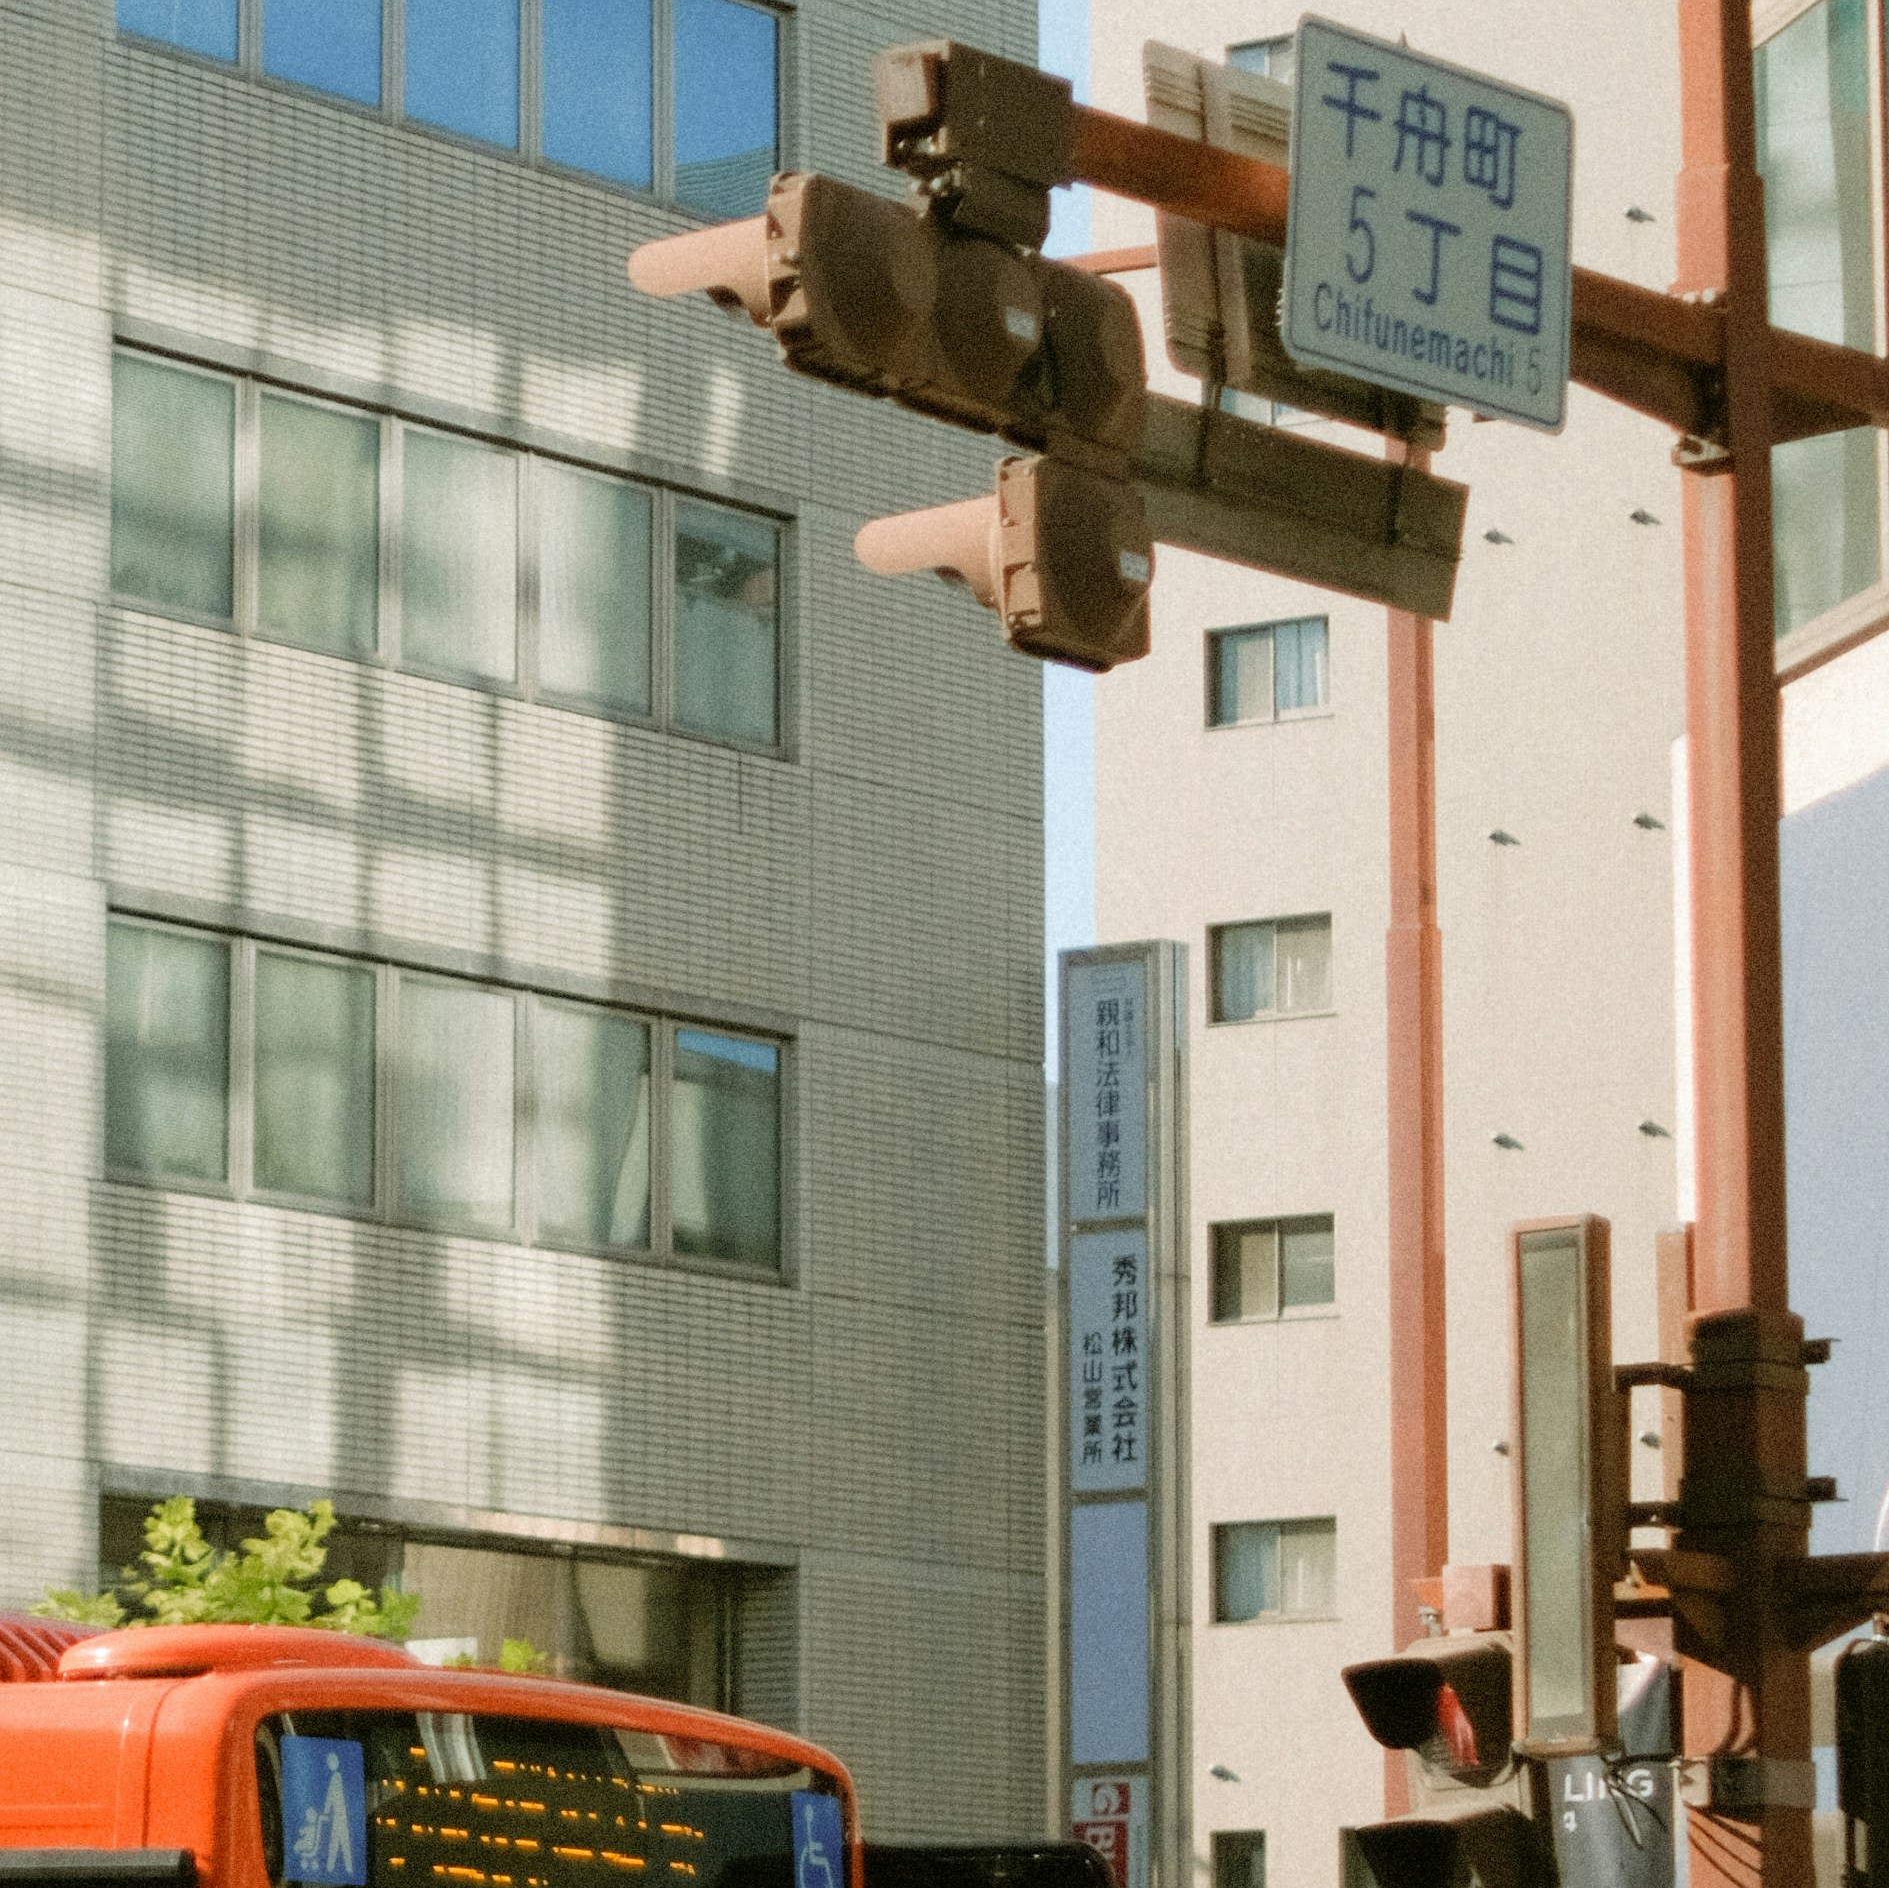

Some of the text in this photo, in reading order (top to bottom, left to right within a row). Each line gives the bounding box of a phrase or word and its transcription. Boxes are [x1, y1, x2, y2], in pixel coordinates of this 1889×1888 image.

[1322, 61, 1522, 210] 千舟町
[1345, 186, 1545, 336] 5丁目
[1527, 347, 1542, 396] 5
[1082, 1331, 1103, 1465] 松山営業所
[1112, 1254, 1138, 1463] 秀邦株式会社
